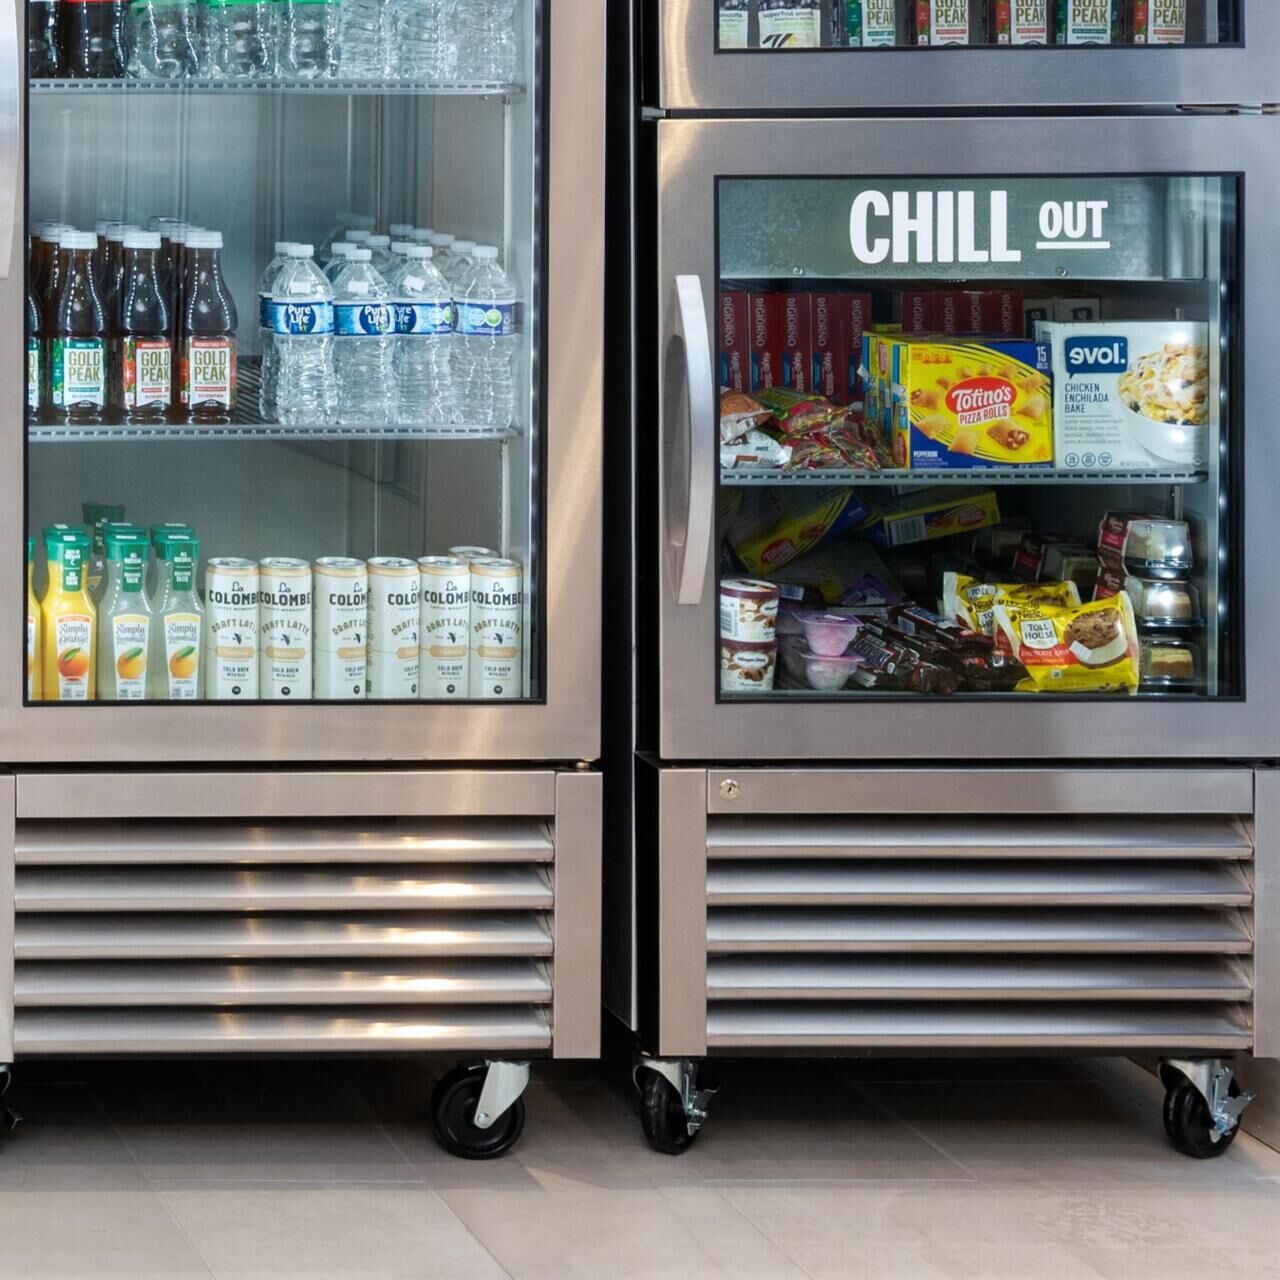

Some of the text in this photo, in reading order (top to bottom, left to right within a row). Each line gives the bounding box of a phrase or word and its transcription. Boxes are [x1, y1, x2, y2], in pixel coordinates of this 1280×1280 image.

[935, 10, 967, 23] PEAK
[849, 190, 1109, 264] CHILL OUT
[287, 305, 312, 318] Pure
[289, 312, 309, 325] Life
[724, 297, 734, 346] DIGIORNO
[68, 352, 101, 367] GOLD
[142, 352, 169, 367] GOLD
[194, 351, 227, 365] GOLD
[1036, 346, 1047, 362] 15
[68, 367, 101, 382] PEAK
[142, 367, 169, 382] PEAK
[194, 367, 226, 381] PEAK
[951, 384, 1013, 406] Totino's
[1064, 383, 1100, 393] CHICKEN
[1064, 394, 1110, 403] ENCHILADA
[1064, 403, 1086, 414] BAKE
[959, 406, 1008, 426] PIZZA ROLLS
[260, 592, 310, 606] COLOMBE
[60, 623, 88, 636] Simply
[116, 624, 145, 636] Simply
[168, 624, 197, 635] Simply
[262, 619, 309, 635] DRAFT LATTE
[1028, 624, 1048, 632] TOLL
